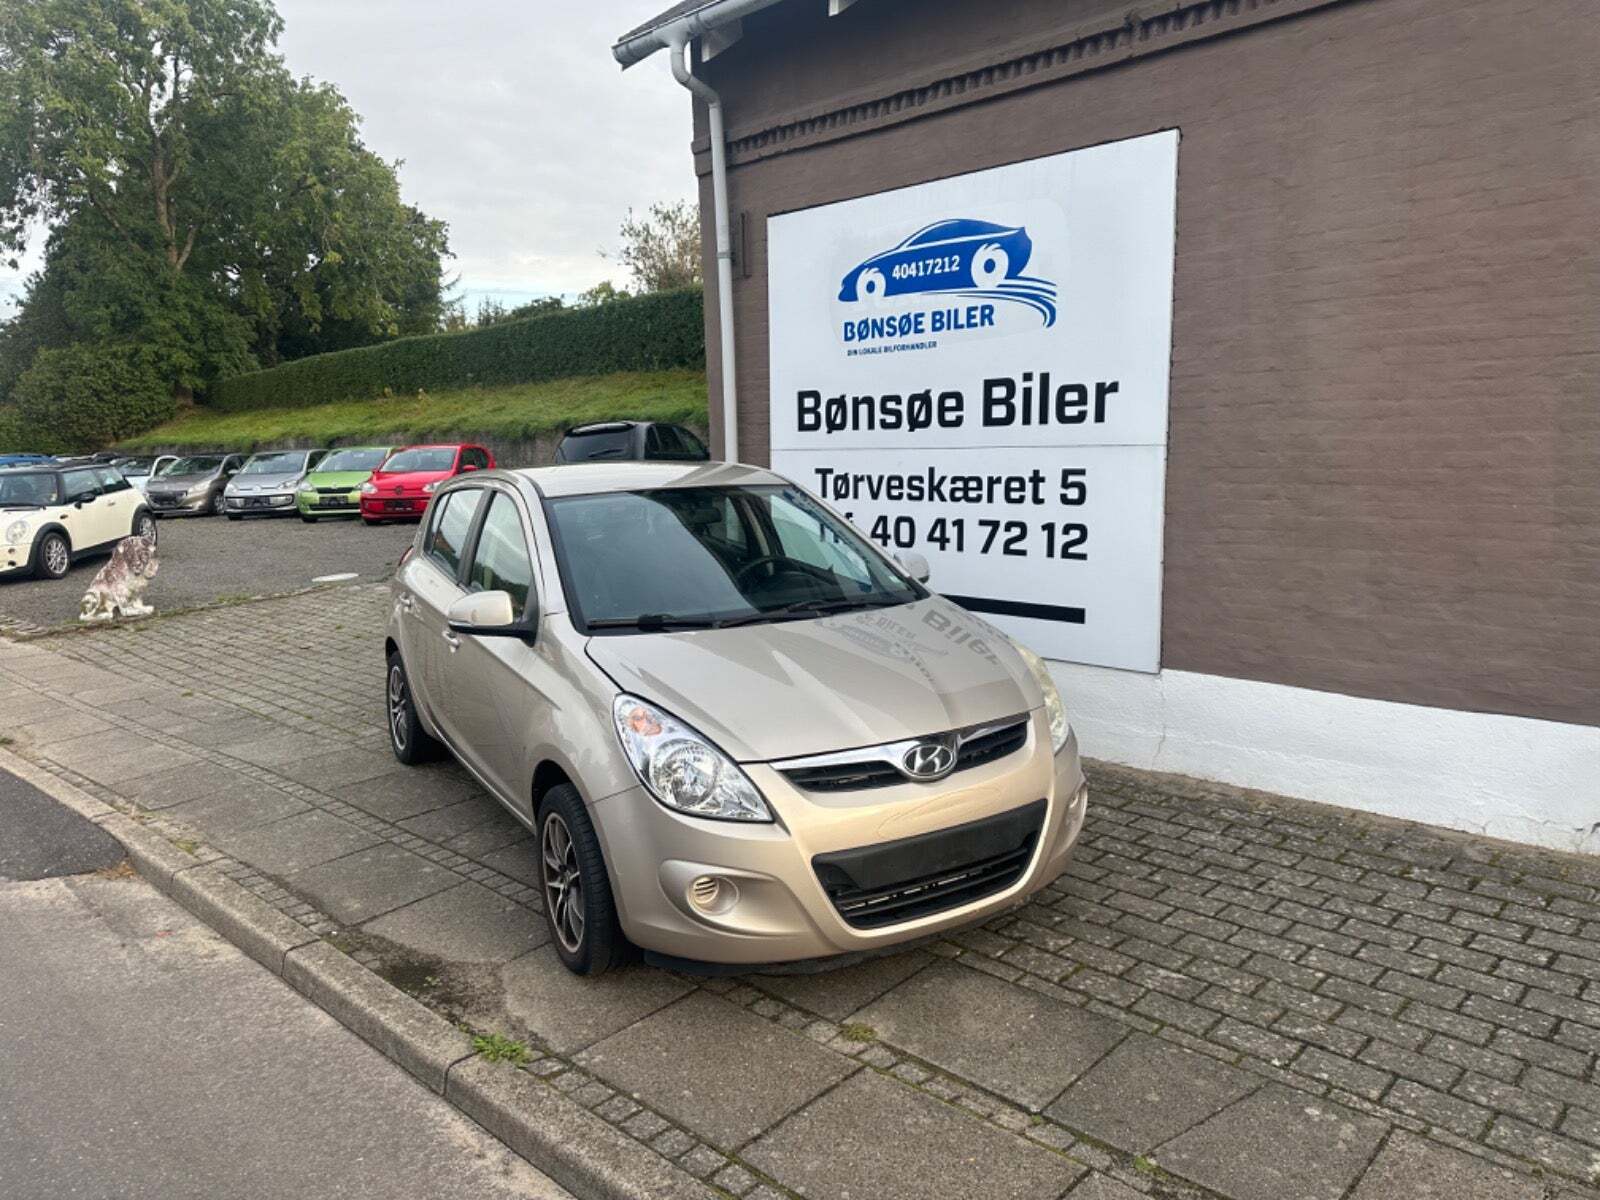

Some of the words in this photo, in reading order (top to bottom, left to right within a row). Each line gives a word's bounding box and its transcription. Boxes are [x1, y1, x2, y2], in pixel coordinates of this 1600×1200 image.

[891, 255, 960, 280] 40417212
[844, 312, 925, 342] BØNSØE
[931, 304, 995, 332] BILER
[847, 348, 858, 356] DIN
[859, 346, 882, 355] LOKALE
[884, 341, 937, 353] BILFORHANDLER
[798, 389, 964, 434] Bønsøe
[982, 372, 1119, 427] Biler
[815, 467, 1046, 505] Tørveskæret
[1059, 469, 1087, 506] 5
[870, 515, 916, 548] 40
[927, 517, 965, 552] 41
[979, 520, 1028, 556] 72
[1041, 521, 1088, 560] 12
